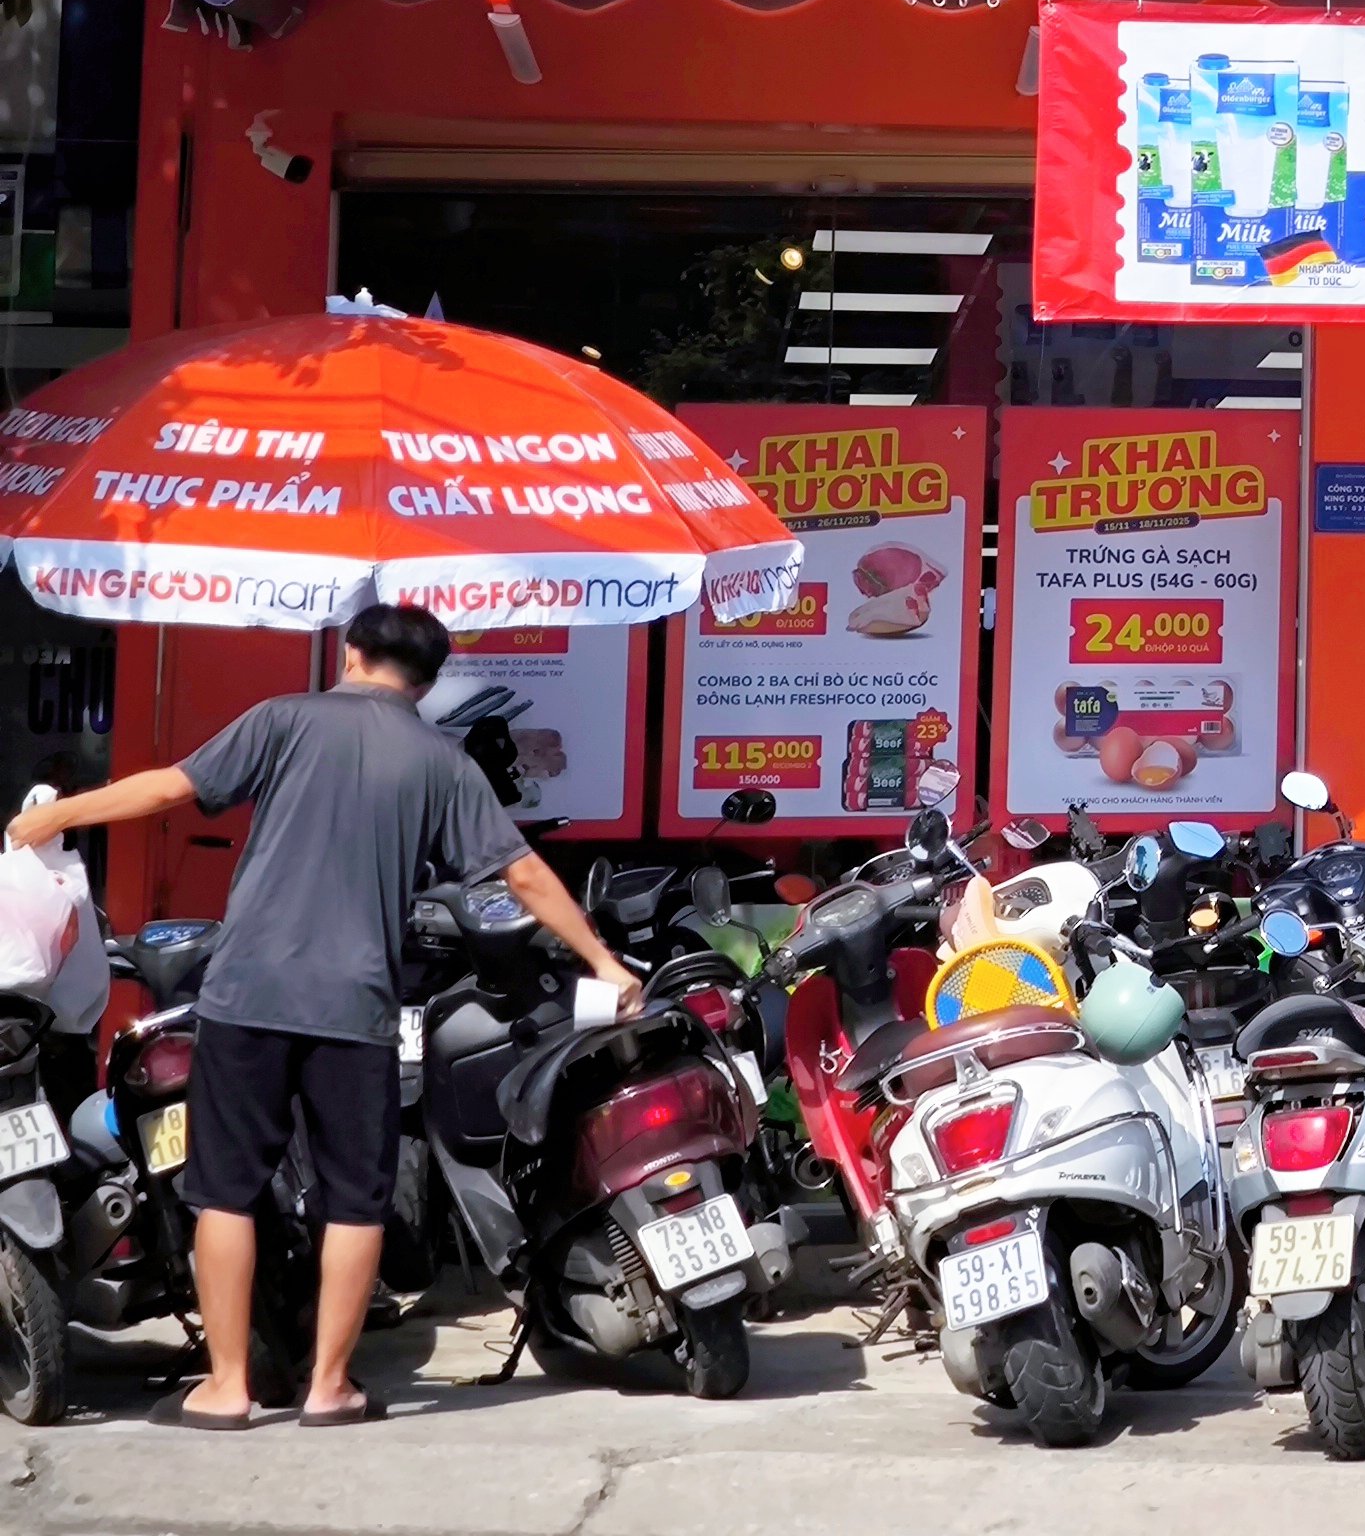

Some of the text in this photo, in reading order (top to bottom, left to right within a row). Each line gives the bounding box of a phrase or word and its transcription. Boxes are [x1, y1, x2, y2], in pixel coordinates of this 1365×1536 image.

[1216, 222, 1272, 244] Milk
[153, 418, 325, 466] SIÊU THỊ
[381, 430, 617, 463] TƯƠI NGON
[761, 431, 896, 478] KHAI
[1084, 435, 1212, 478] KHAI
[93, 470, 342, 516] THỰC PHẨM
[388, 475, 652, 522] CHẤT LƯỢNG
[1034, 469, 1261, 520] TRƯƠNG
[1323, 495, 1346, 503] KING
[817, 515, 871, 528] 26/11/2025
[1065, 542, 1232, 570] TRỨNG GÀ SẠCH
[35, 565, 341, 613] KINGFOODmart
[1035, 571, 1259, 593] TAFA PLUS (54G 60G)
[1084, 611, 1211, 653] 24.000
[697, 670, 939, 687] COMBO BA CHỈ BÒ ÚC NGŨ CỐC
[696, 691, 927, 708] ĐÔNG LẠNH FRESHFOCO (200G)
[1072, 695, 1102, 715] tafa
[701, 740, 814, 770] 115.000
[737, 774, 781, 785] 150.000
[1296, 1026, 1335, 1040] SYM
[642, 1151, 682, 1172] HONDA
[655, 1204, 727, 1253] 73-N8
[1268, 1218, 1337, 1256] 59-X1
[667, 1231, 739, 1280] 3538
[955, 1241, 1027, 1289] 59-X1
[1256, 1251, 1347, 1291] 474.76
[951, 1269, 1041, 1325] 598.65
